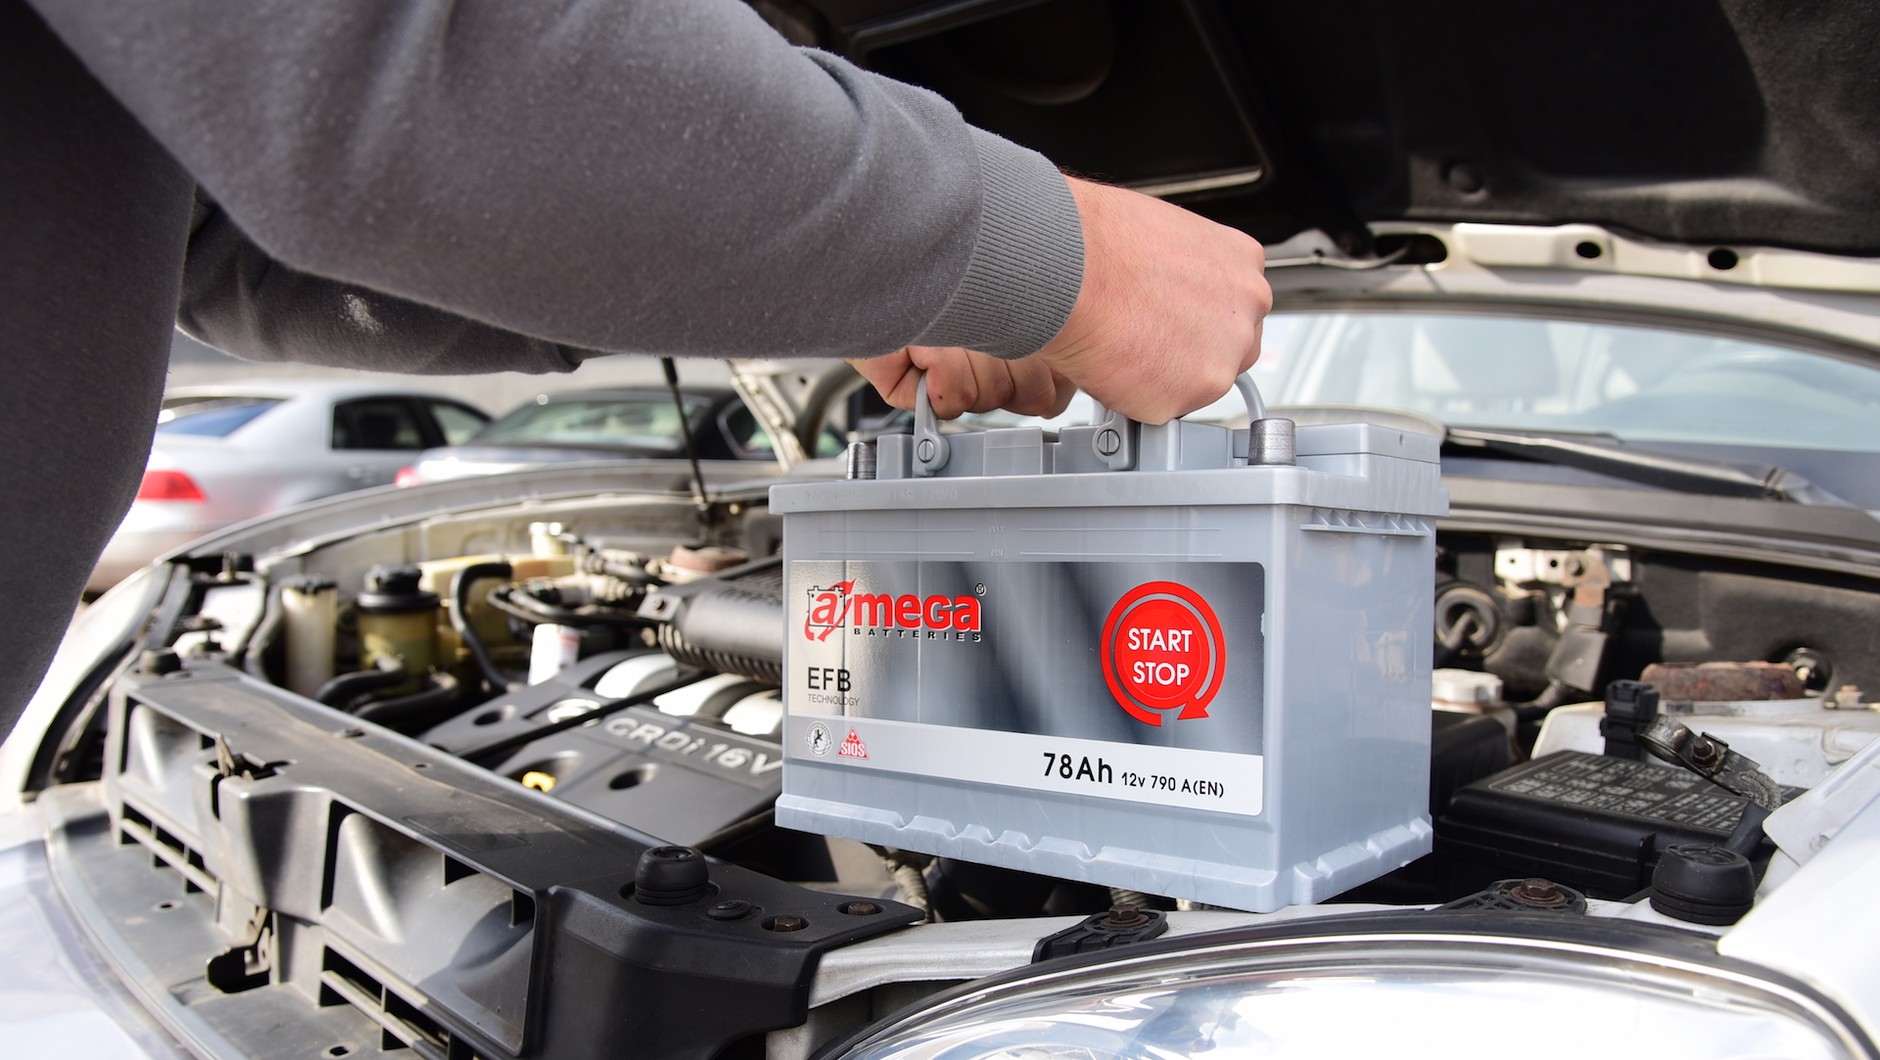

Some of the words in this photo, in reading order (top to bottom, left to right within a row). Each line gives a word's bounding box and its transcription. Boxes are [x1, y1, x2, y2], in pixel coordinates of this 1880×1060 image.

[854, 628, 981, 642] BATTERIES
[1127, 627, 1193, 652] START
[807, 666, 851, 692] EFB
[1132, 661, 1190, 686] STOP
[807, 693, 860, 706] TECHNOLOGY
[605, 717, 705, 754] CRDi
[1043, 752, 1113, 784] 78Ah
[1121, 772, 1146, 788] 12v
[1150, 775, 1176, 791] 790
[1181, 779, 1224, 798] A(EN)
